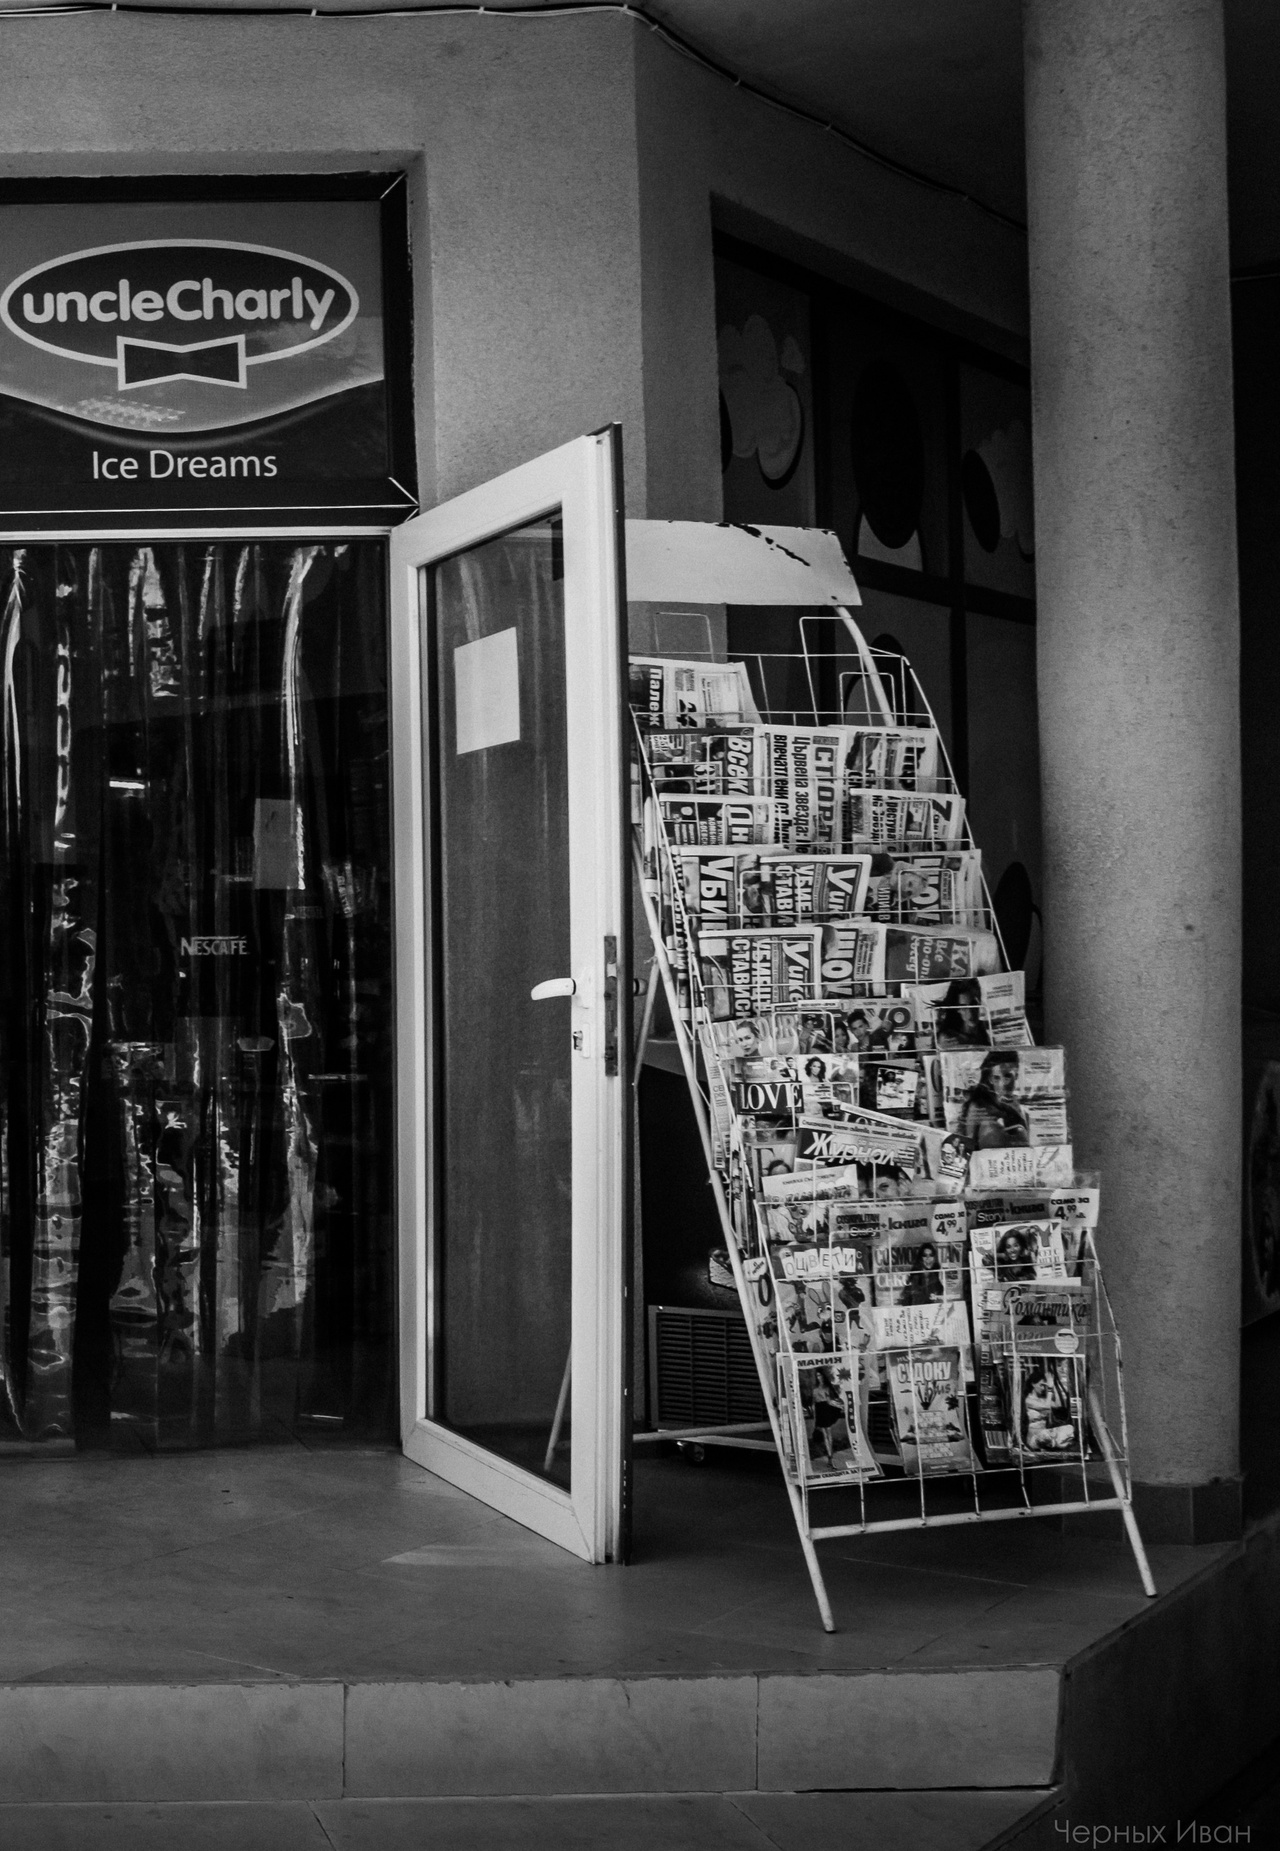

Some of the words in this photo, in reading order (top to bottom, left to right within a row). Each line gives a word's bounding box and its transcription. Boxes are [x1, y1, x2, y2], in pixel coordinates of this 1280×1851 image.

[22, 276, 335, 331] uncleCharly
[92, 450, 139, 480] Ice
[149, 449, 279, 479] Dreams
[649, 668, 663, 727] Палеж
[791, 736, 811, 788] Цървена
[792, 791, 810, 836] звезда:
[775, 865, 795, 926] СТАВИ
[739, 1082, 803, 1111] LOVE
[803, 1131, 895, 1167] Журнал
[888, 1217, 928, 1230] книга
[934, 1212, 956, 1220] само
[1003, 1286, 1087, 1323] Романтика
[796, 1356, 843, 1367] МАНИЯ
